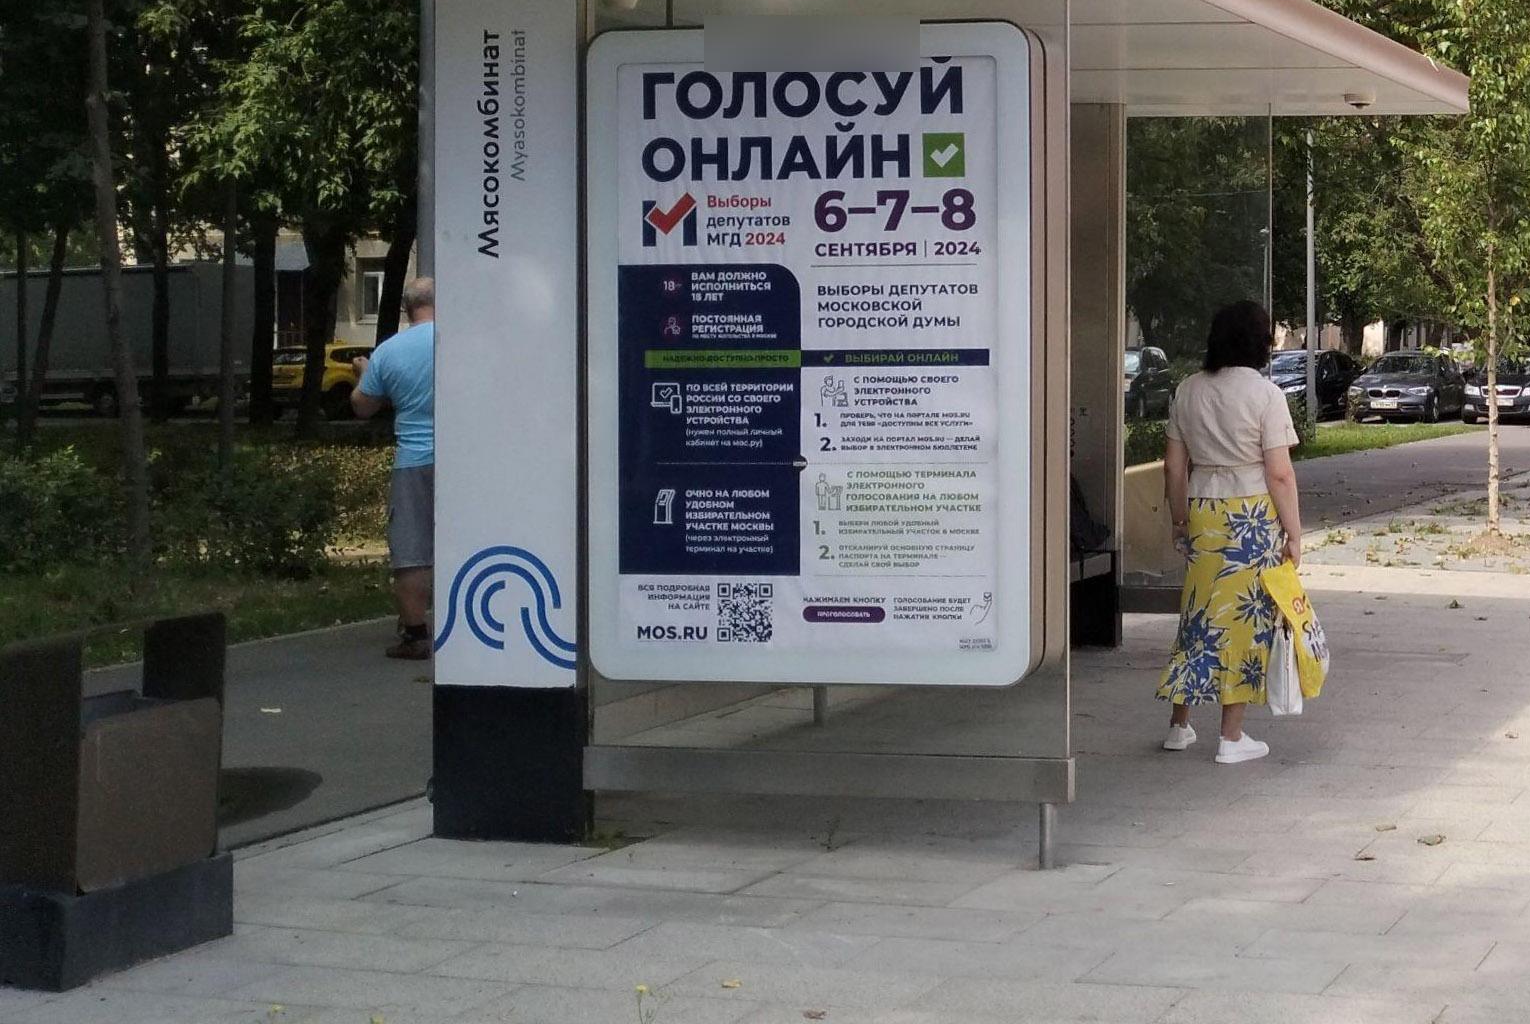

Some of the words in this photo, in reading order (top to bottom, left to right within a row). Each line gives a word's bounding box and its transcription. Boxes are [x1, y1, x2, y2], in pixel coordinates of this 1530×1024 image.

[642, 57, 963, 120] ГОЛОСУЙ
[510, 29, 528, 182] Myasokombinat
[477, 30, 500, 258] Мясокомбинат
[642, 122, 911, 182] ОНЛАЙН
[707, 195, 772, 210] Выборы
[706, 215, 791, 229] депутатов
[707, 232, 742, 248] МГД
[745, 232, 786, 246] 2024
[814, 241, 917, 258] СЕНТЯБРЯ
[934, 241, 982, 256] 2024
[691, 272, 715, 281] ВАМ
[717, 272, 767, 282] ДОЛЖНО
[691, 282, 771, 291] ИСПОЛНИТЬСЯ
[817, 285, 884, 296] ВЫБОРЫ
[889, 284, 978, 297] ДЕПУТАТОВ
[691, 293, 702, 301] 18
[704, 293, 724, 302] ЛЕТ
[817, 298, 922, 312] МОСКОВСКОЙ
[692, 315, 762, 324] ПОСТОЯННАЯ
[818, 314, 908, 329] ГОРОДСКОЙ
[912, 316, 960, 329] ДУМЫ
[692, 325, 764, 335] РЕГИСТРАЦИЯ
[845, 351, 904, 363] ВЫБИРАЙ
[907, 350, 959, 362] ОНЛАЙН
[863, 376, 918, 385] ПОМОЩЬЮ
[686, 384, 700, 392] ПО
[703, 382, 728, 392] ВСЕЙ
[730, 383, 793, 392] ТЕРРИТОРИИ
[854, 387, 931, 395] ЭЛЕКТРОННОГО
[686, 394, 725, 402] РОССИИ
[728, 394, 741, 402] СО
[743, 394, 781, 402] СВОЕГО
[854, 397, 918, 406] УСТРОЙСТВА
[686, 405, 762, 414] ЭЛЕКТРОННОГО
[686, 415, 749, 425] УСТРОЙСТВА
[814, 413, 827, 427] 1.
[820, 437, 837, 452] 2.
[856, 471, 912, 479] ПОМОЩЬЮ
[915, 470, 977, 478] ТЕРМИНАЛА
[685, 490, 713, 498] ОЧНО
[715, 490, 729, 498] НА
[731, 489, 770, 498] ЛЮБОМ
[846, 493, 920, 501] ГОЛОСОВАНИЯ
[939, 493, 979, 501] ЛЮБОМ
[685, 501, 734, 510] УДОБНОМ
[846, 504, 933, 512] ИЗБИРАТЕЛЬНОМ
[936, 504, 982, 512] УЧАСТКЕ
[685, 511, 770, 520] ИЗБИРАТЕЛЬНОМ
[685, 522, 728, 531] УЧАСТКЕ
[731, 522, 774, 531] МОСКВЫ
[813, 520, 826, 535] 1.
[818, 544, 835, 560] 2.
[656, 584, 711, 592] ПОДРОБНАЯ
[683, 602, 711, 610] САЙТЕ
[637, 625, 708, 640] MOS.RU
